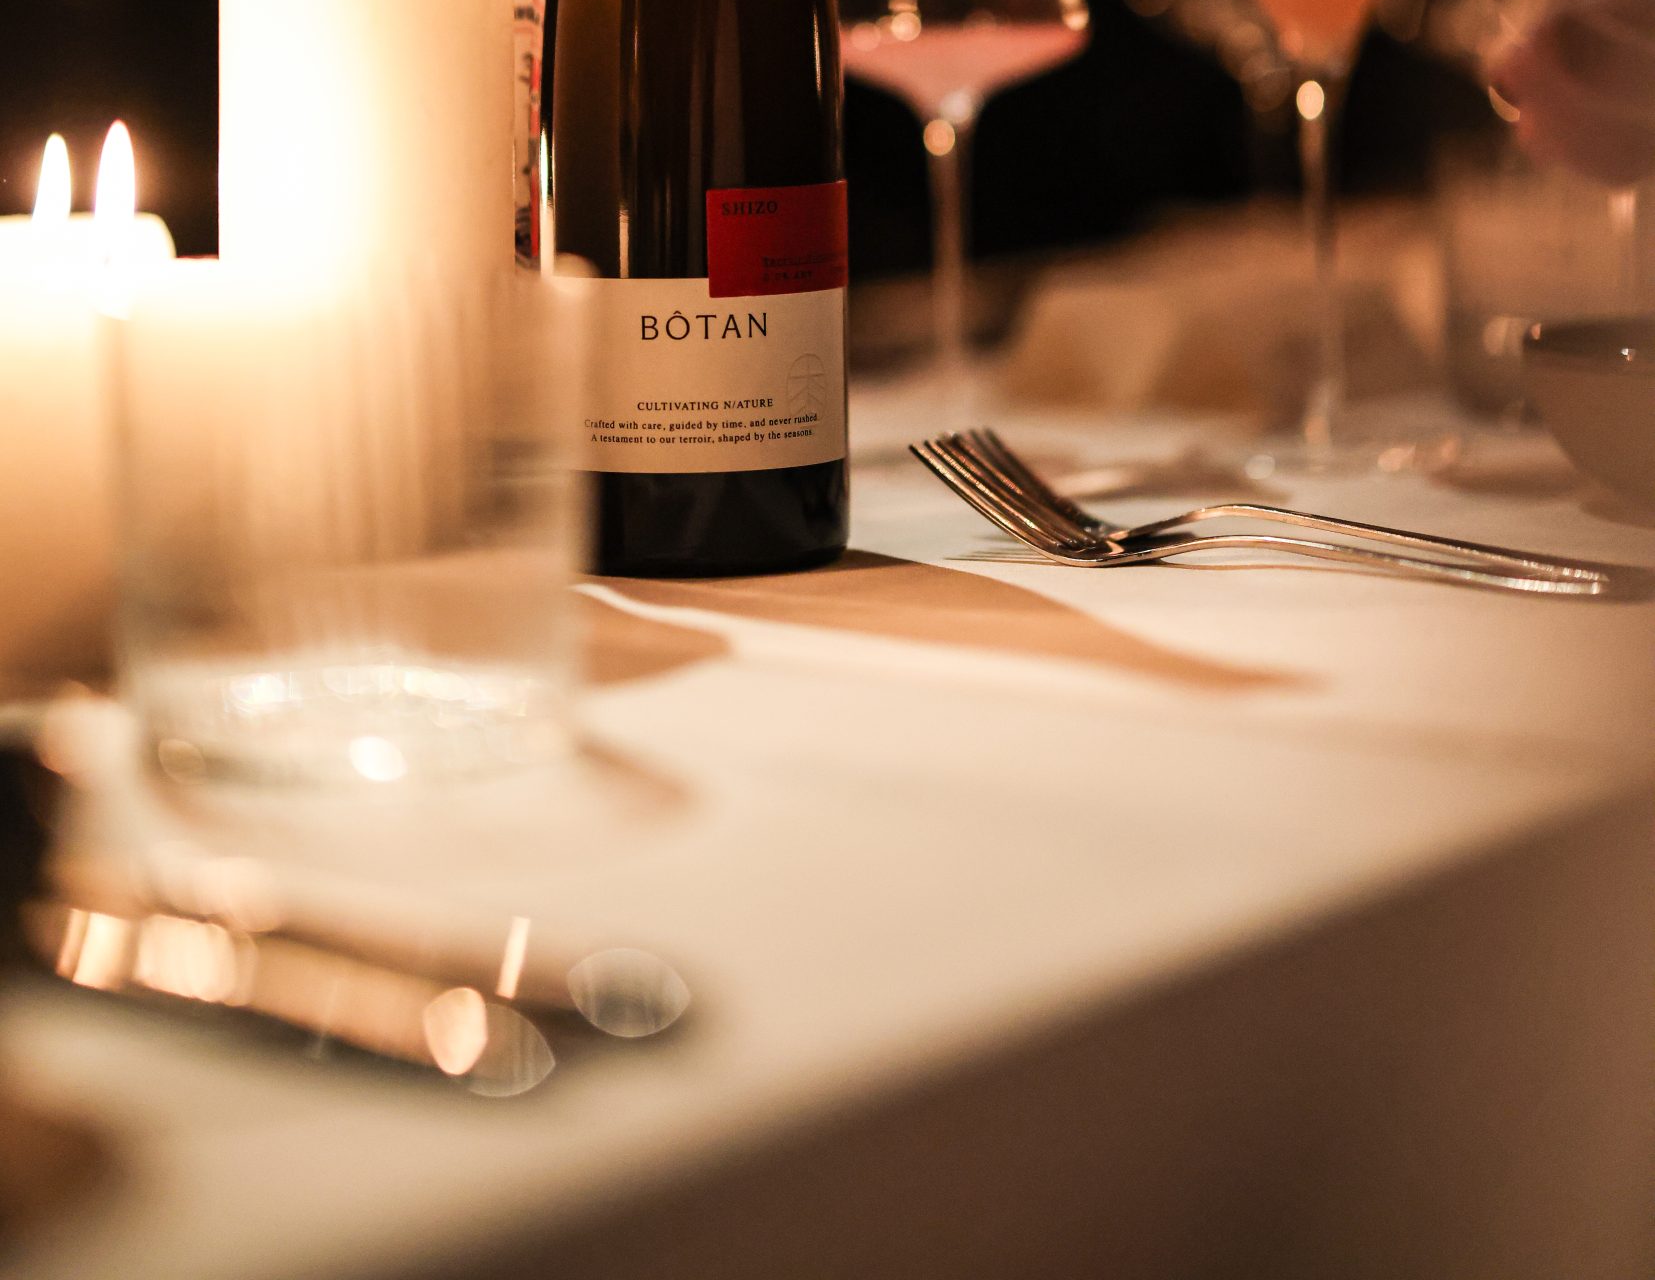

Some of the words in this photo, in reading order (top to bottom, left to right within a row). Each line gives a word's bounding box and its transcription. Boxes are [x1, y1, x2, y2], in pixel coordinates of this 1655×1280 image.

[721, 200, 779, 217] SHIZO
[641, 310, 767, 341] BÔTAN
[637, 401, 719, 411] CULTIVATING
[723, 398, 774, 410] N/ATURE
[585, 419, 615, 430] Crafted
[618, 421, 638, 430] with
[669, 421, 702, 431] guided
[706, 421, 718, 431] by
[749, 418, 766, 427] and
[769, 417, 791, 426] never
[591, 434, 598, 442] A
[600, 434, 643, 444] testament
[646, 435, 656, 444] to
[659, 436, 676, 444] our
[679, 434, 715, 444] terroir,
[718, 433, 751, 444] shaped
[754, 432, 765, 443] by
[768, 430, 781, 440] the
